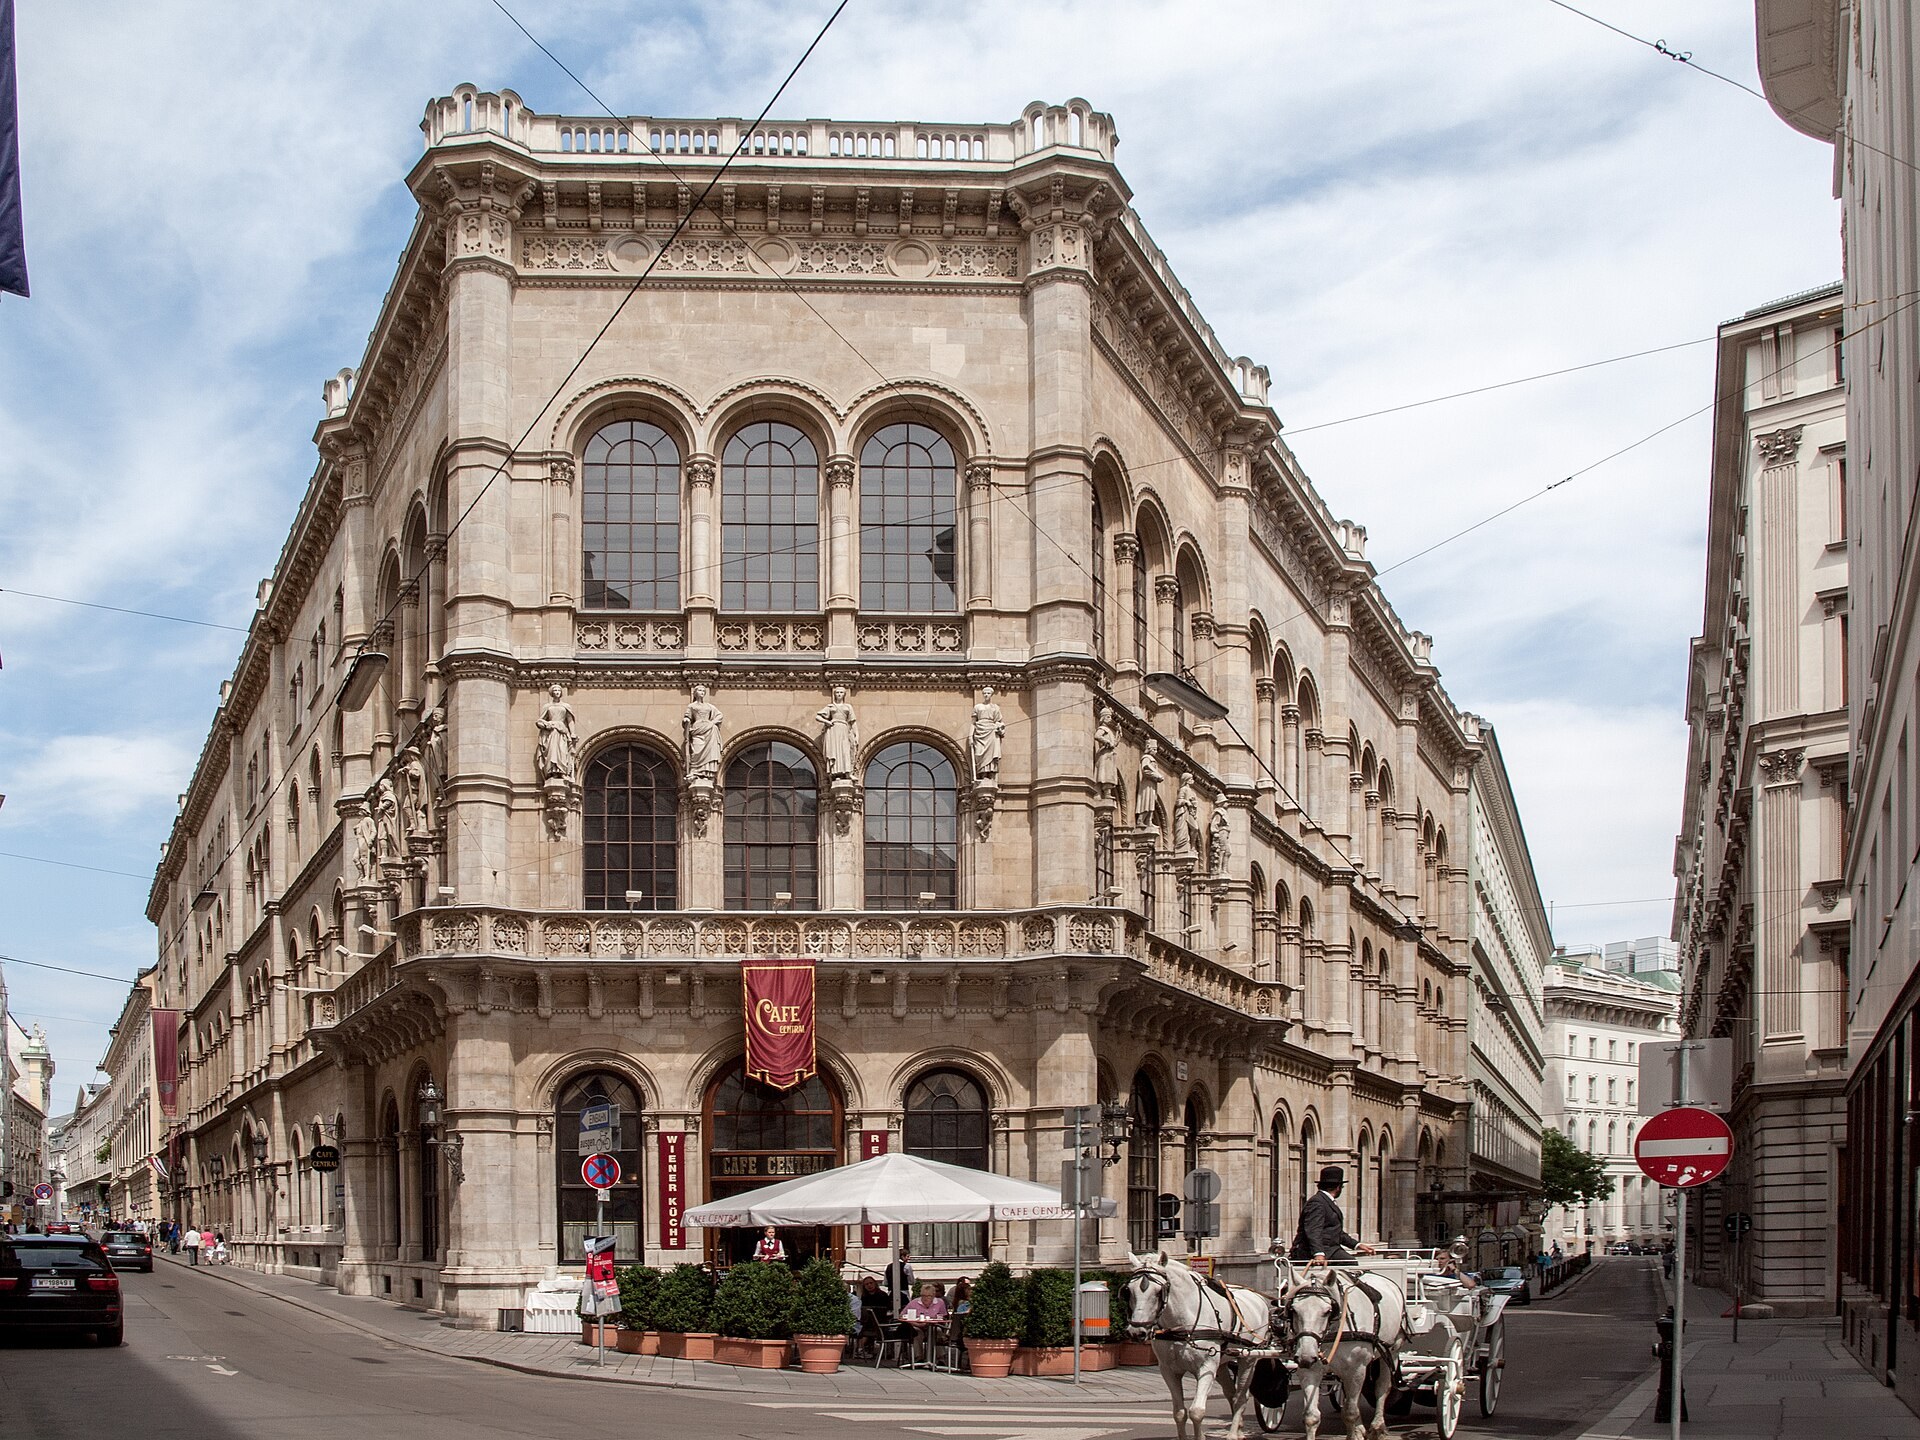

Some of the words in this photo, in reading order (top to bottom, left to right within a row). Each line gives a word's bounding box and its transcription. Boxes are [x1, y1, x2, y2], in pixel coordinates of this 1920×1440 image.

[755, 998, 801, 1037] CAFE
[779, 1024, 805, 1034] CENTRAL
[589, 1111, 607, 1125] EINBAHN
[312, 1160, 338, 1168] CENTRAL
[666, 1135, 678, 1192] WIENER
[723, 1156, 757, 1175] CAFE
[767, 1156, 828, 1175] CENTRAL
[1001, 1207, 1028, 1217] CAFE
[1032, 1205, 1076, 1215] CENTRA
[668, 1197, 678, 1246] KÜCHE
[687, 1214, 706, 1224] CAFE
[709, 1213, 742, 1223] CENTRAL
